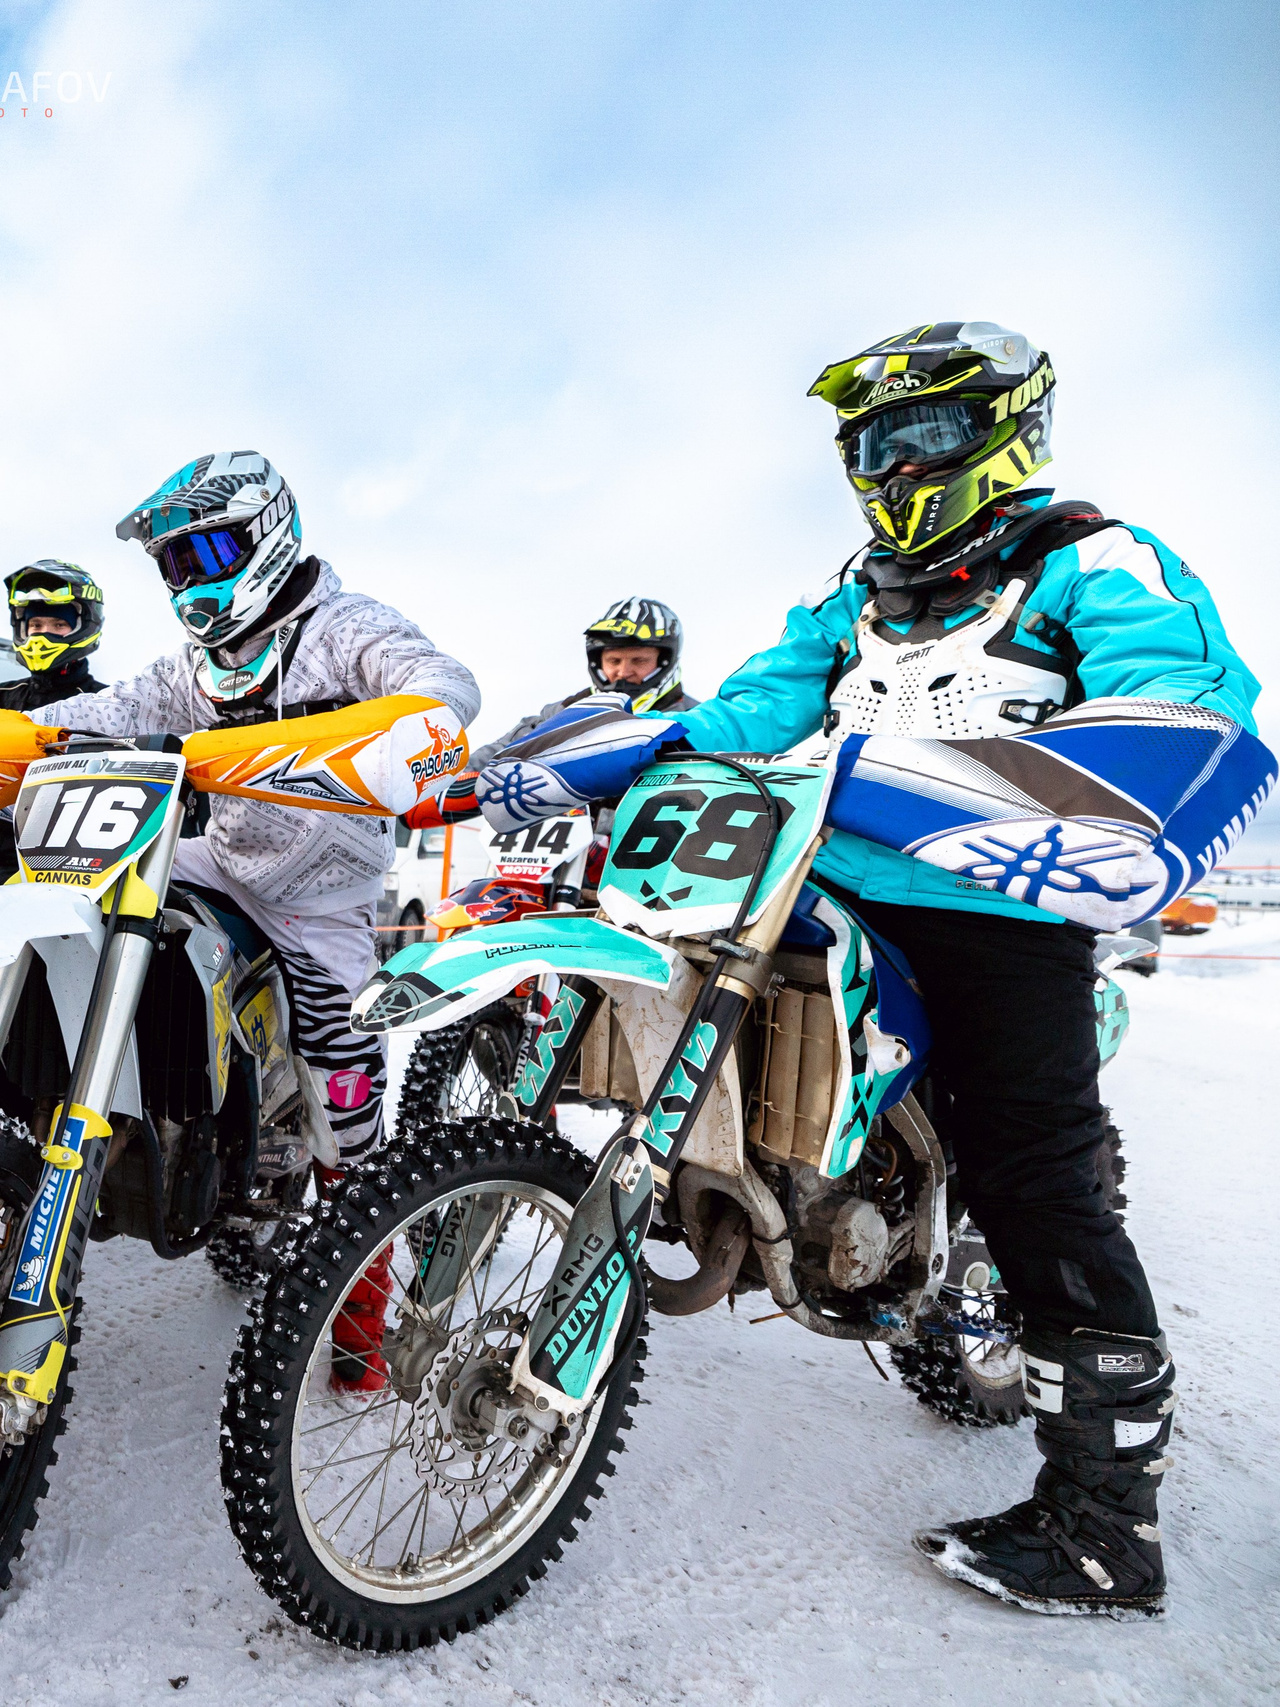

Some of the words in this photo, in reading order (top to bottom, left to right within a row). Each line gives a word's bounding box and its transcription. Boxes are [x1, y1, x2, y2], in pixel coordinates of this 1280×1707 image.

[864, 373, 921, 404] Airoh
[989, 361, 1055, 425] 100%
[926, 495, 941, 531] AIROH
[896, 645, 935, 665] LEATT
[220, 674, 252, 688] ORTEMA
[28, 760, 71, 776] FATIKHOV
[636, 774, 679, 786] ZHOLOB
[489, 821, 574, 854] 414
[611, 789, 796, 881] 68
[1197, 772, 1276, 873] YAMAHA
[66, 857, 103, 867] ANG
[500, 856, 539, 864] Nazarov
[541, 857, 550, 865] V.
[502, 866, 543, 876] MOTUL
[35, 872, 92, 885] CANVAS
[336, 1073, 361, 1108] 7
[640, 1018, 718, 1158] KYB
[30, 1130, 71, 1251] MICHEN
